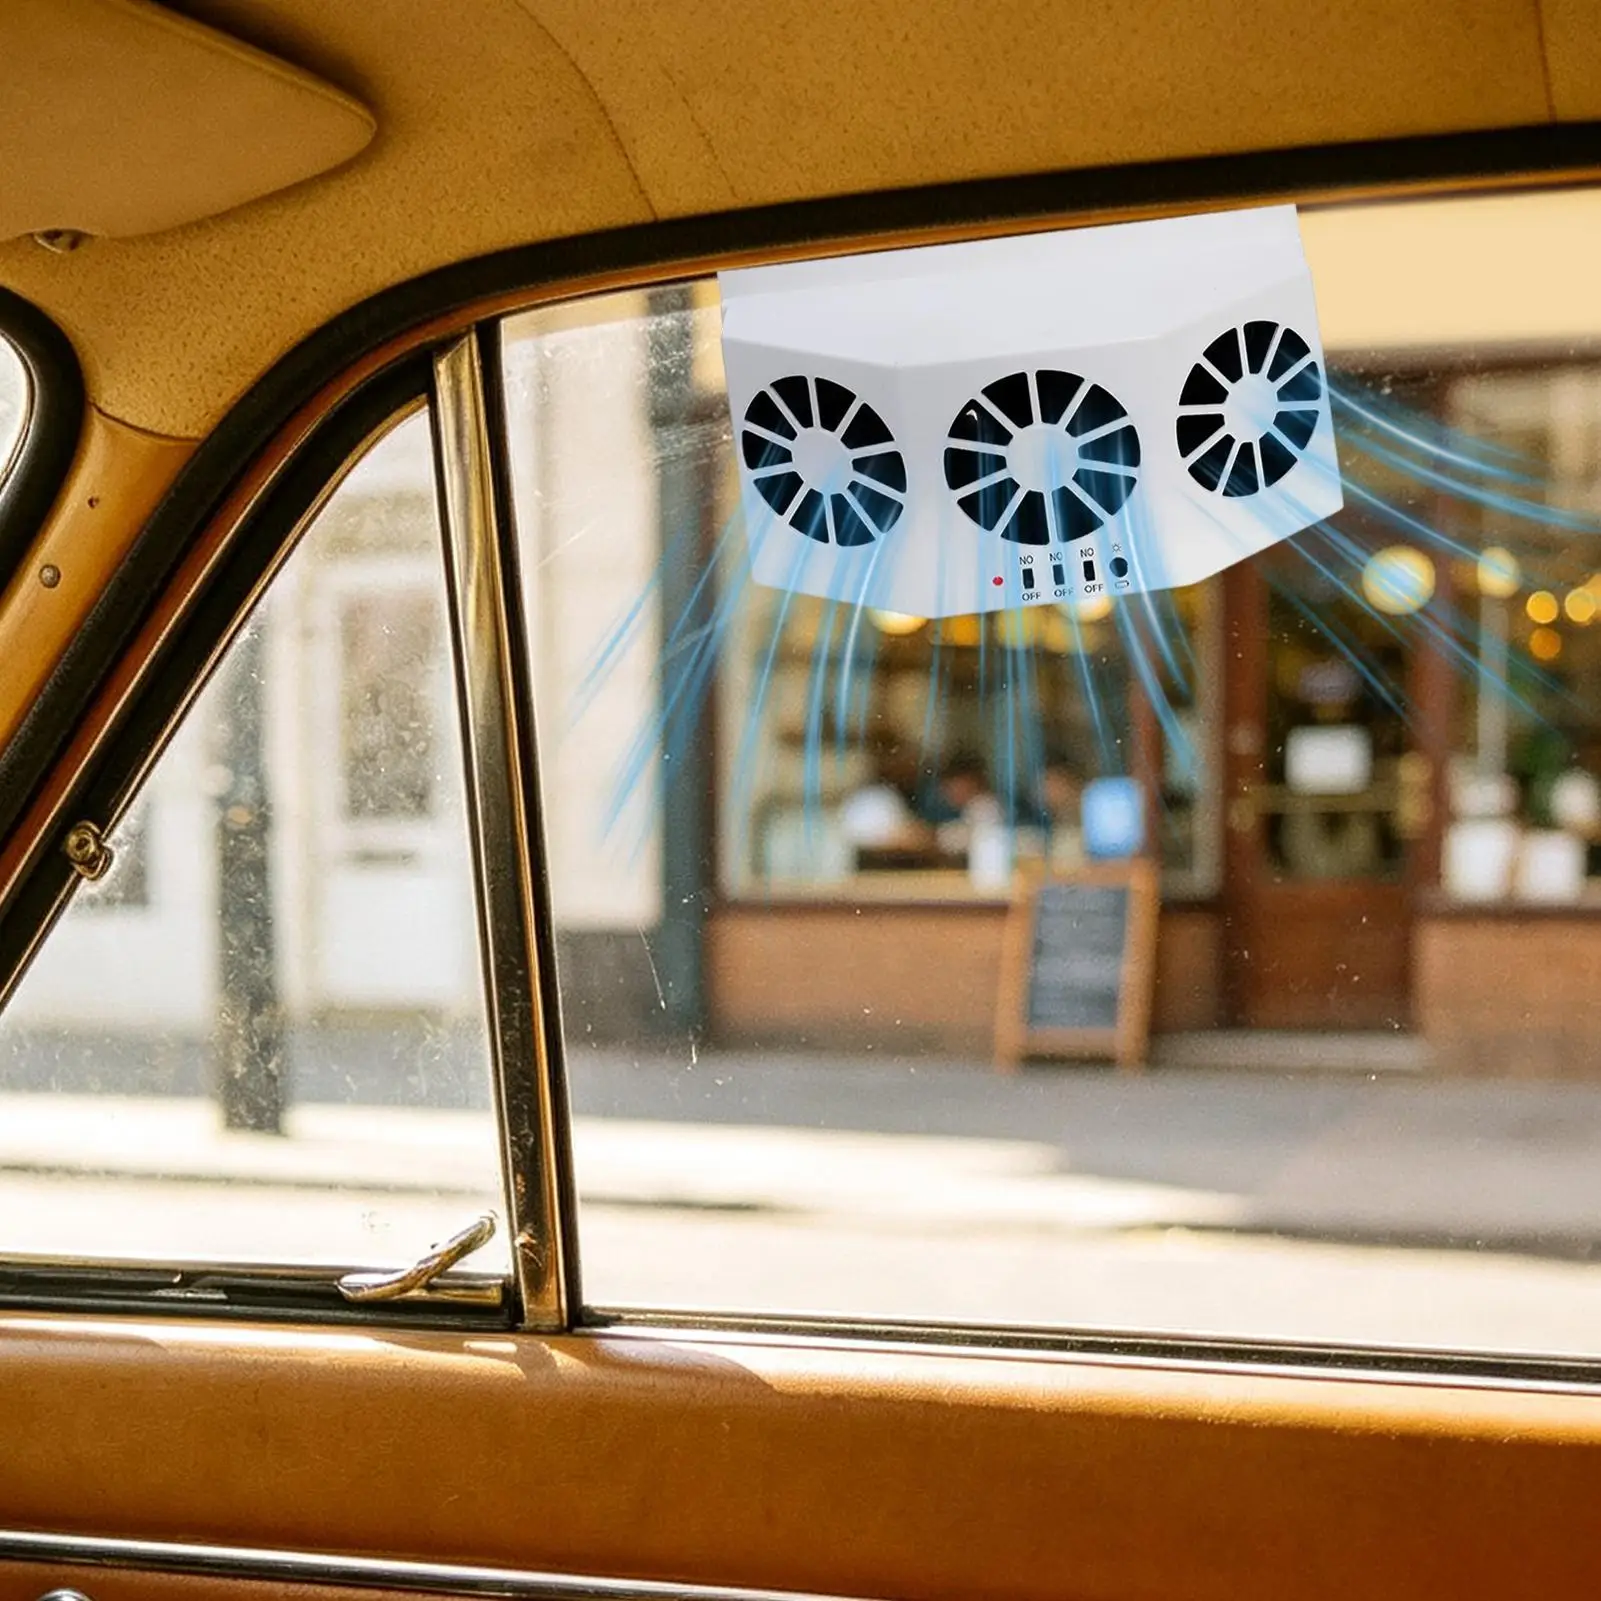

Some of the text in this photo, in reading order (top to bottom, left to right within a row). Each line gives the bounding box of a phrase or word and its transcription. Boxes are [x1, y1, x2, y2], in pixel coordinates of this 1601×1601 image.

[1049, 552, 1063, 562] NO
[1080, 547, 1095, 557] NO
[1019, 555, 1034, 565] NO
[1054, 587, 1074, 597] OFF
[1084, 584, 1104, 594] OFF
[1022, 591, 1041, 601] OFF
